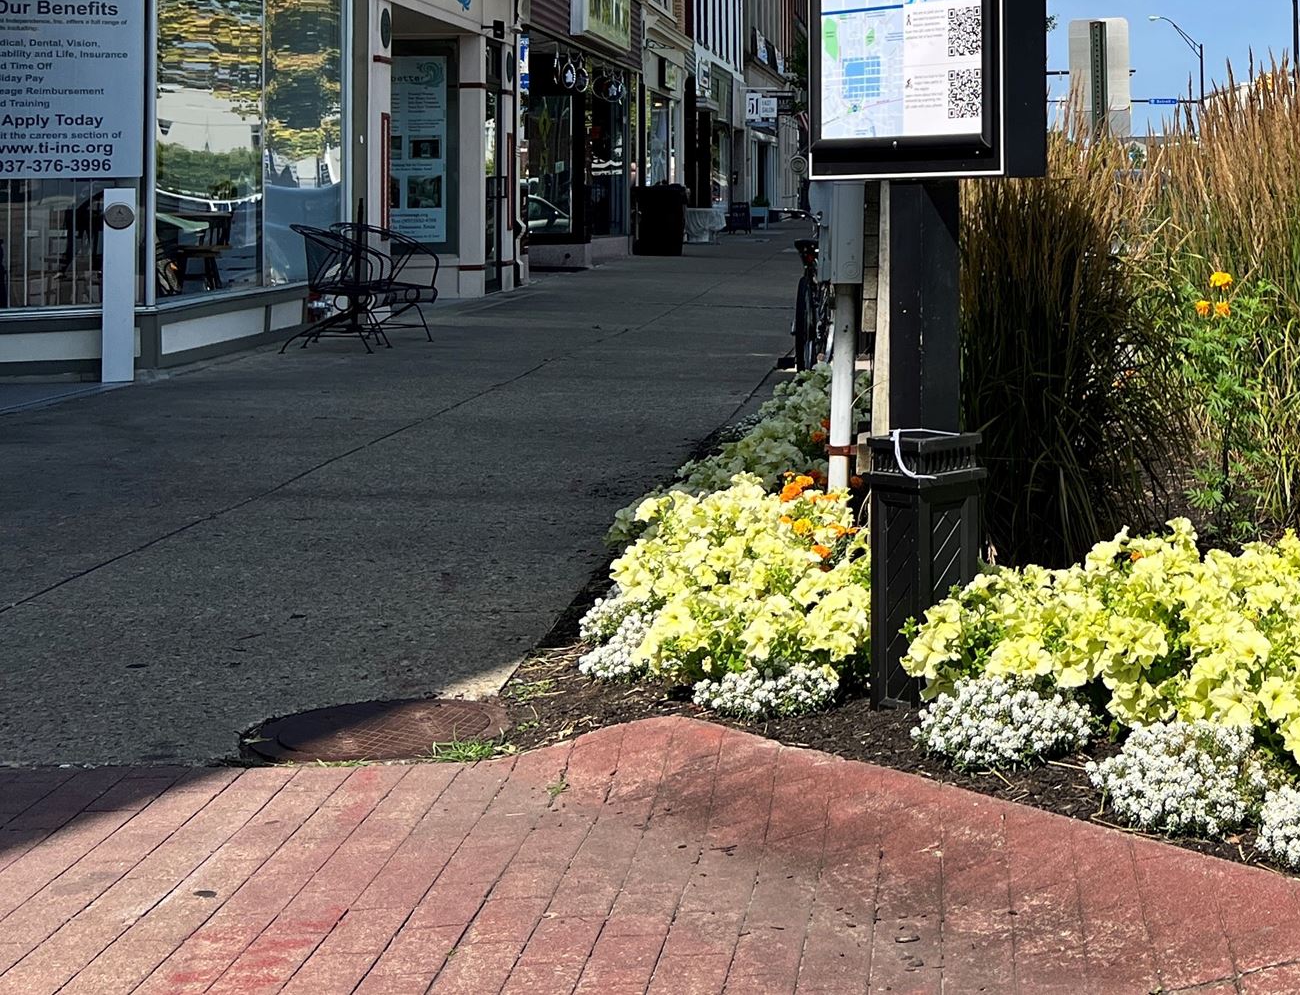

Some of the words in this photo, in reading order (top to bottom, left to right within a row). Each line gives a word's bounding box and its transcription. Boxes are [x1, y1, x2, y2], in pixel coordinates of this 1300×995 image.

[0, 0, 31, 15] Our
[37, 0, 118, 16] Benefits
[29, 39, 64, 48] Dental,
[67, 39, 100, 48] Vision,
[0, 50, 31, 59] ability
[56, 51, 78, 59] Life,
[80, 51, 128, 59] Insurance
[10, 62, 34, 70] Time
[37, 62, 53, 70] Off
[25, 74, 44, 84] Pay
[26, 87, 104, 95] Reimbursement
[9, 100, 50, 109] Training
[748, 97, 759, 115] 51
[1, 114, 50, 129] Apply
[55, 114, 104, 128] Today
[112, 131, 122, 139] of
